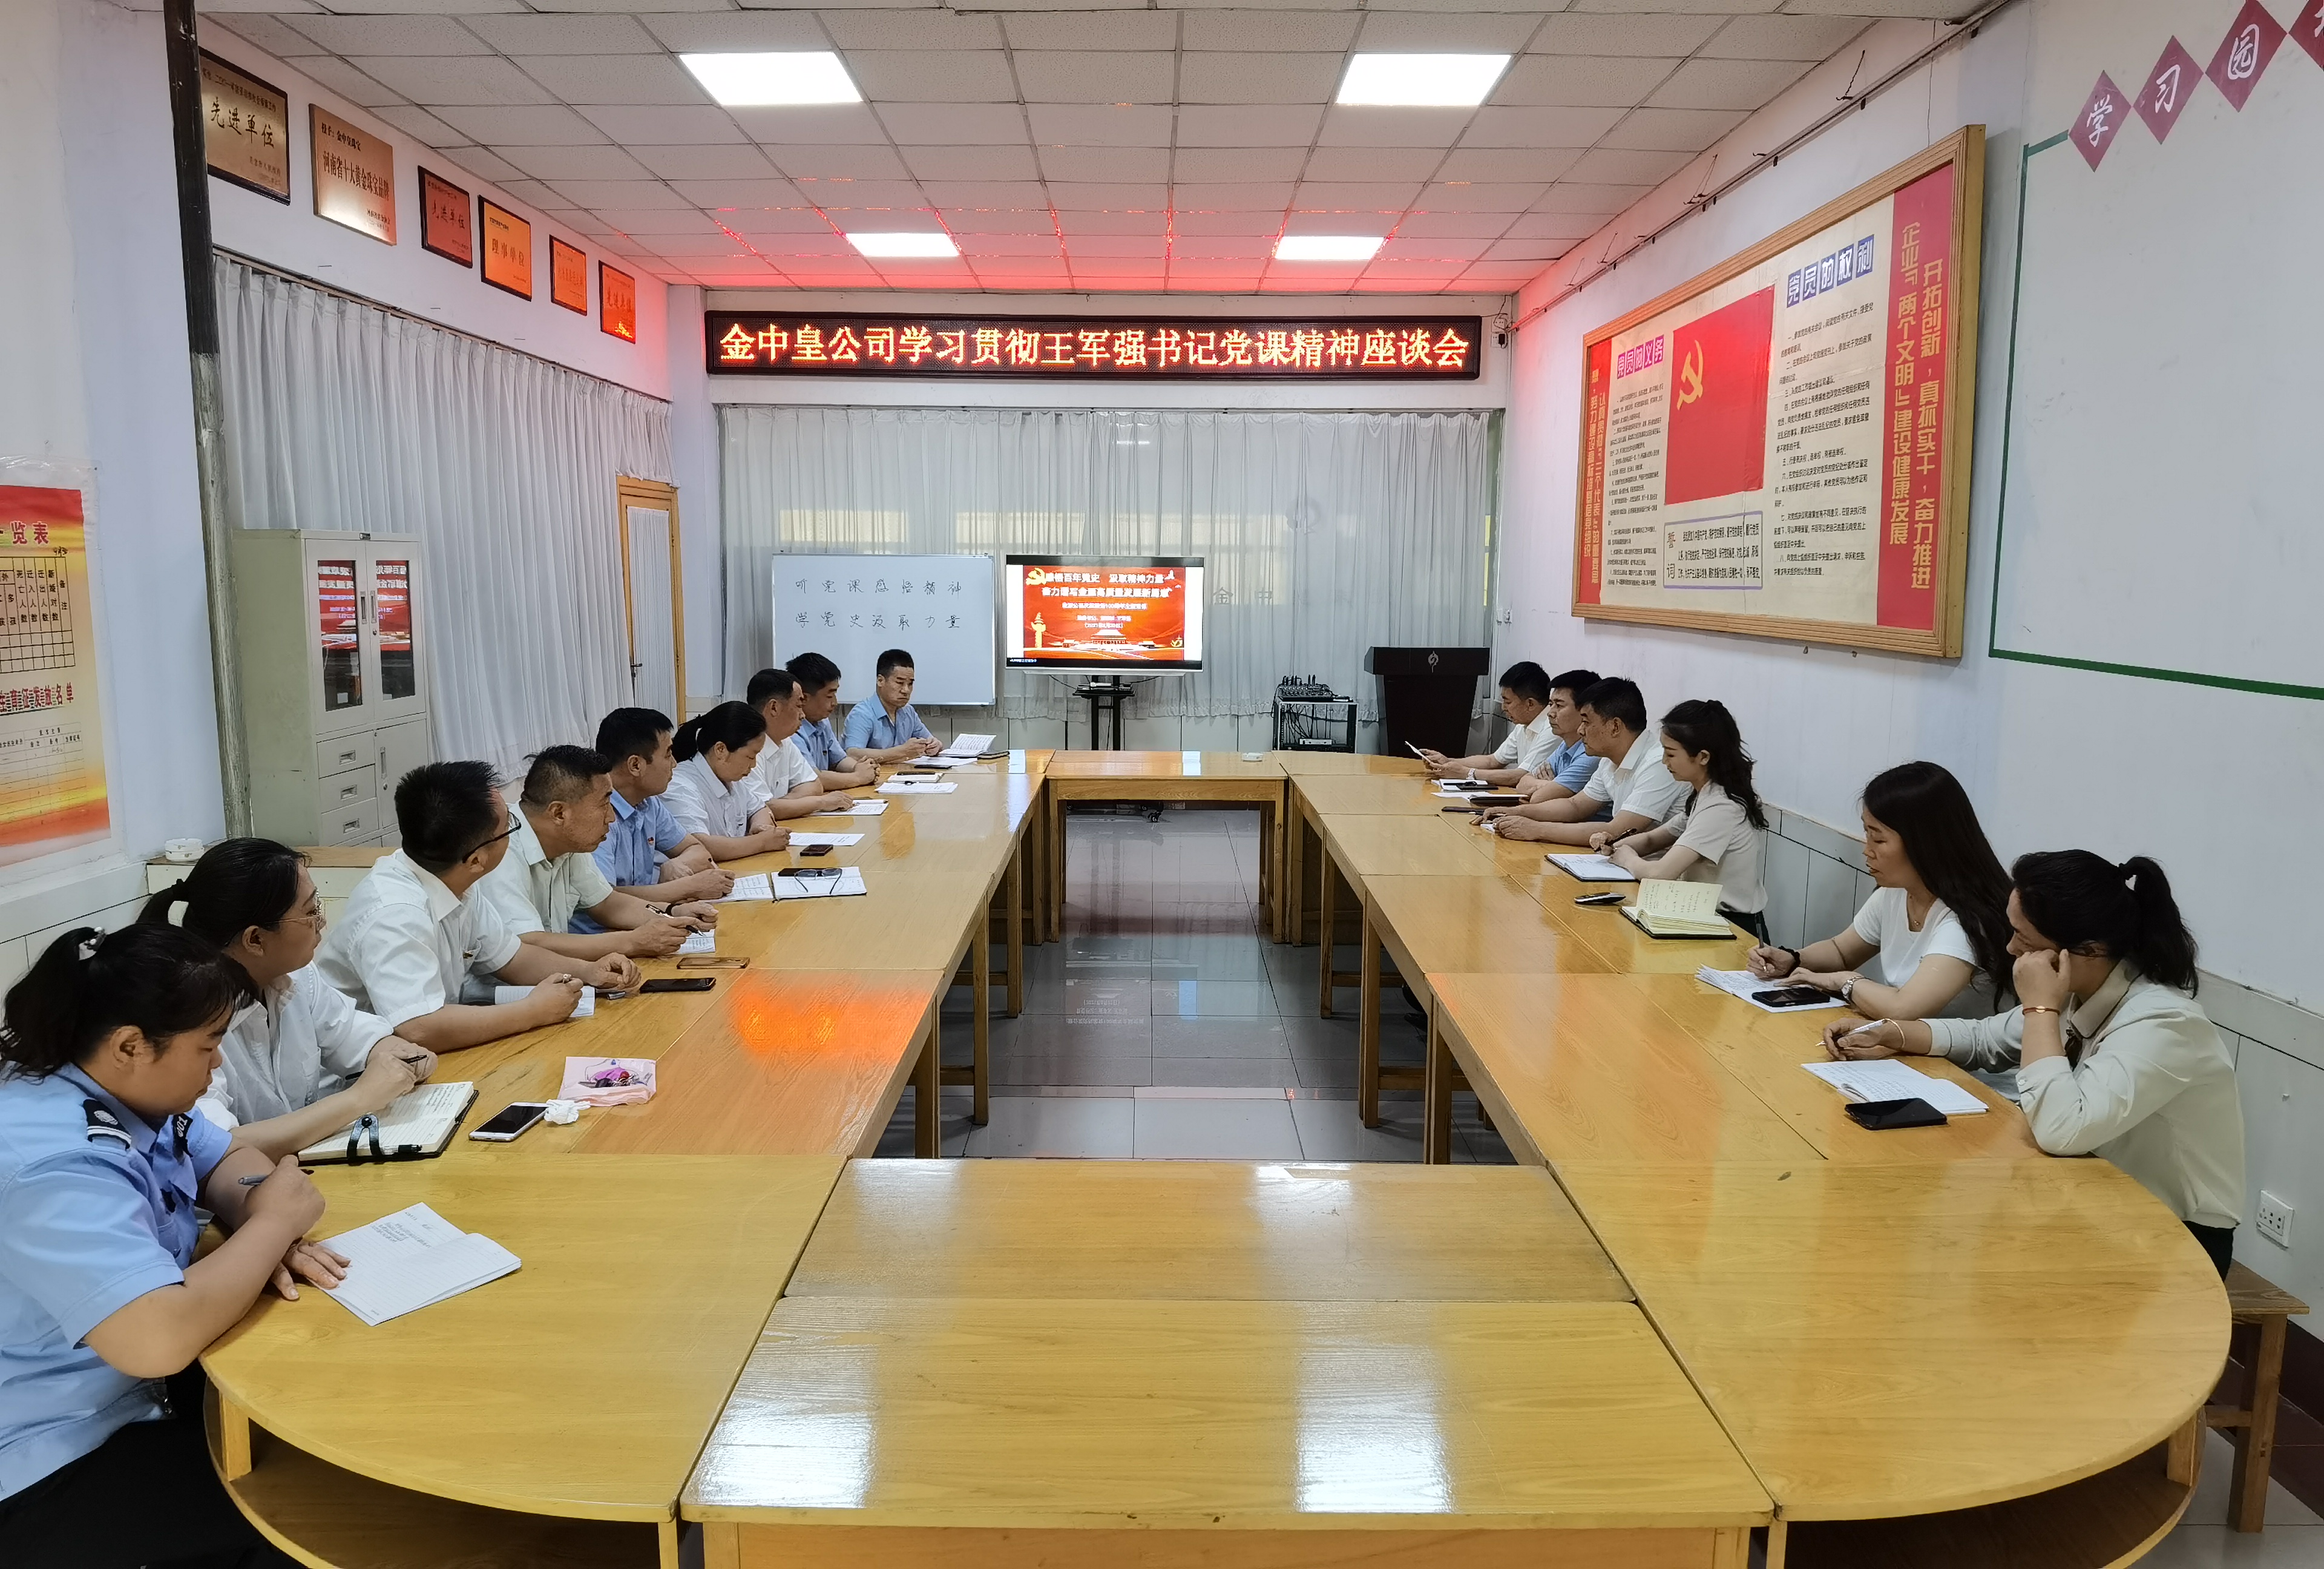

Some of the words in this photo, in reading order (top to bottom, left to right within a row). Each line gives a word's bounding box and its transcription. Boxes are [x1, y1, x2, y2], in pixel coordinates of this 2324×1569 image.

[2087, 5, 2324, 147] 学习园
[211, 97, 274, 148] 先进单位
[323, 151, 389, 202] 河南省十大黄金珠宝品牌
[1787, 238, 1874, 306] 党员的权利
[720, 323, 1469, 367] 金中皇公司学习贯彻王军强书记党课精神座谈会
[1617, 338, 1664, 378] 党员的义务
[0, 521, 49, 545] 览表
[795, 579, 962, 599] 听党课感悟精神
